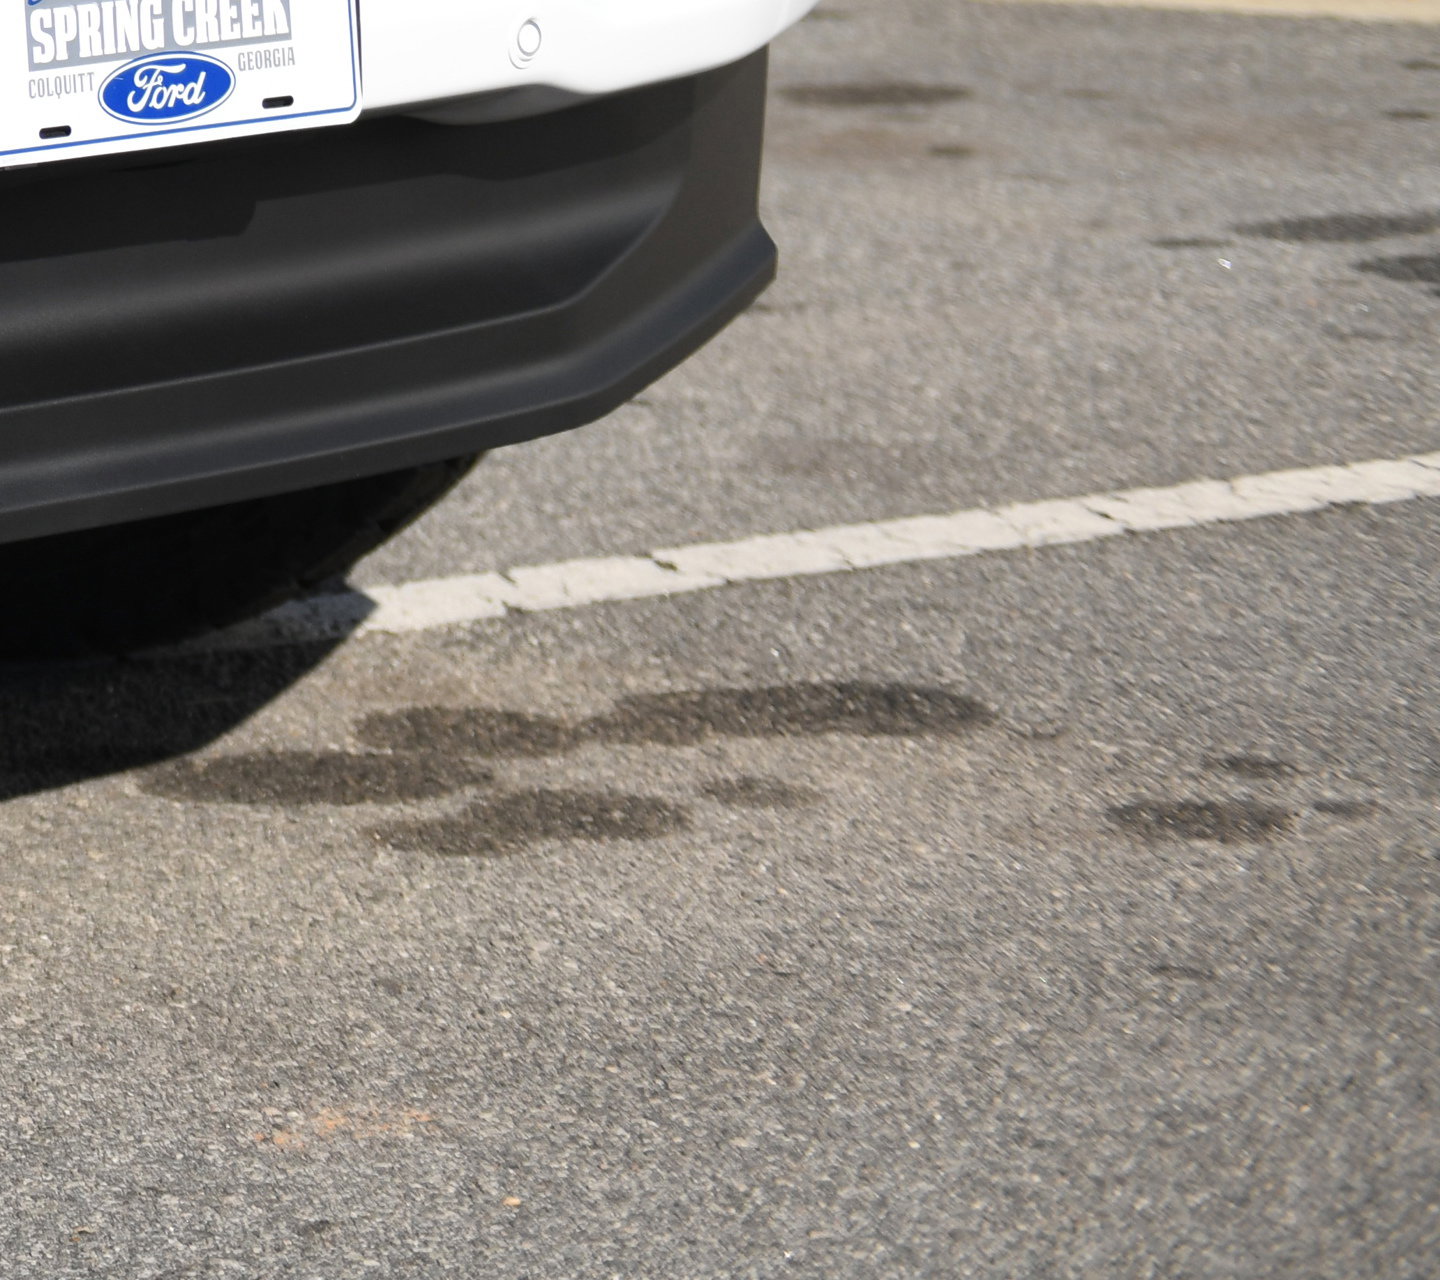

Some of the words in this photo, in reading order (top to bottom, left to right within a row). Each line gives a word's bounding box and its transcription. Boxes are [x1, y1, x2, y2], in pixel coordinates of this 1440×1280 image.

[237, 46, 296, 72] GEORGIA
[28, 71, 95, 100] COLQUITT
[127, 62, 207, 113] Ford
